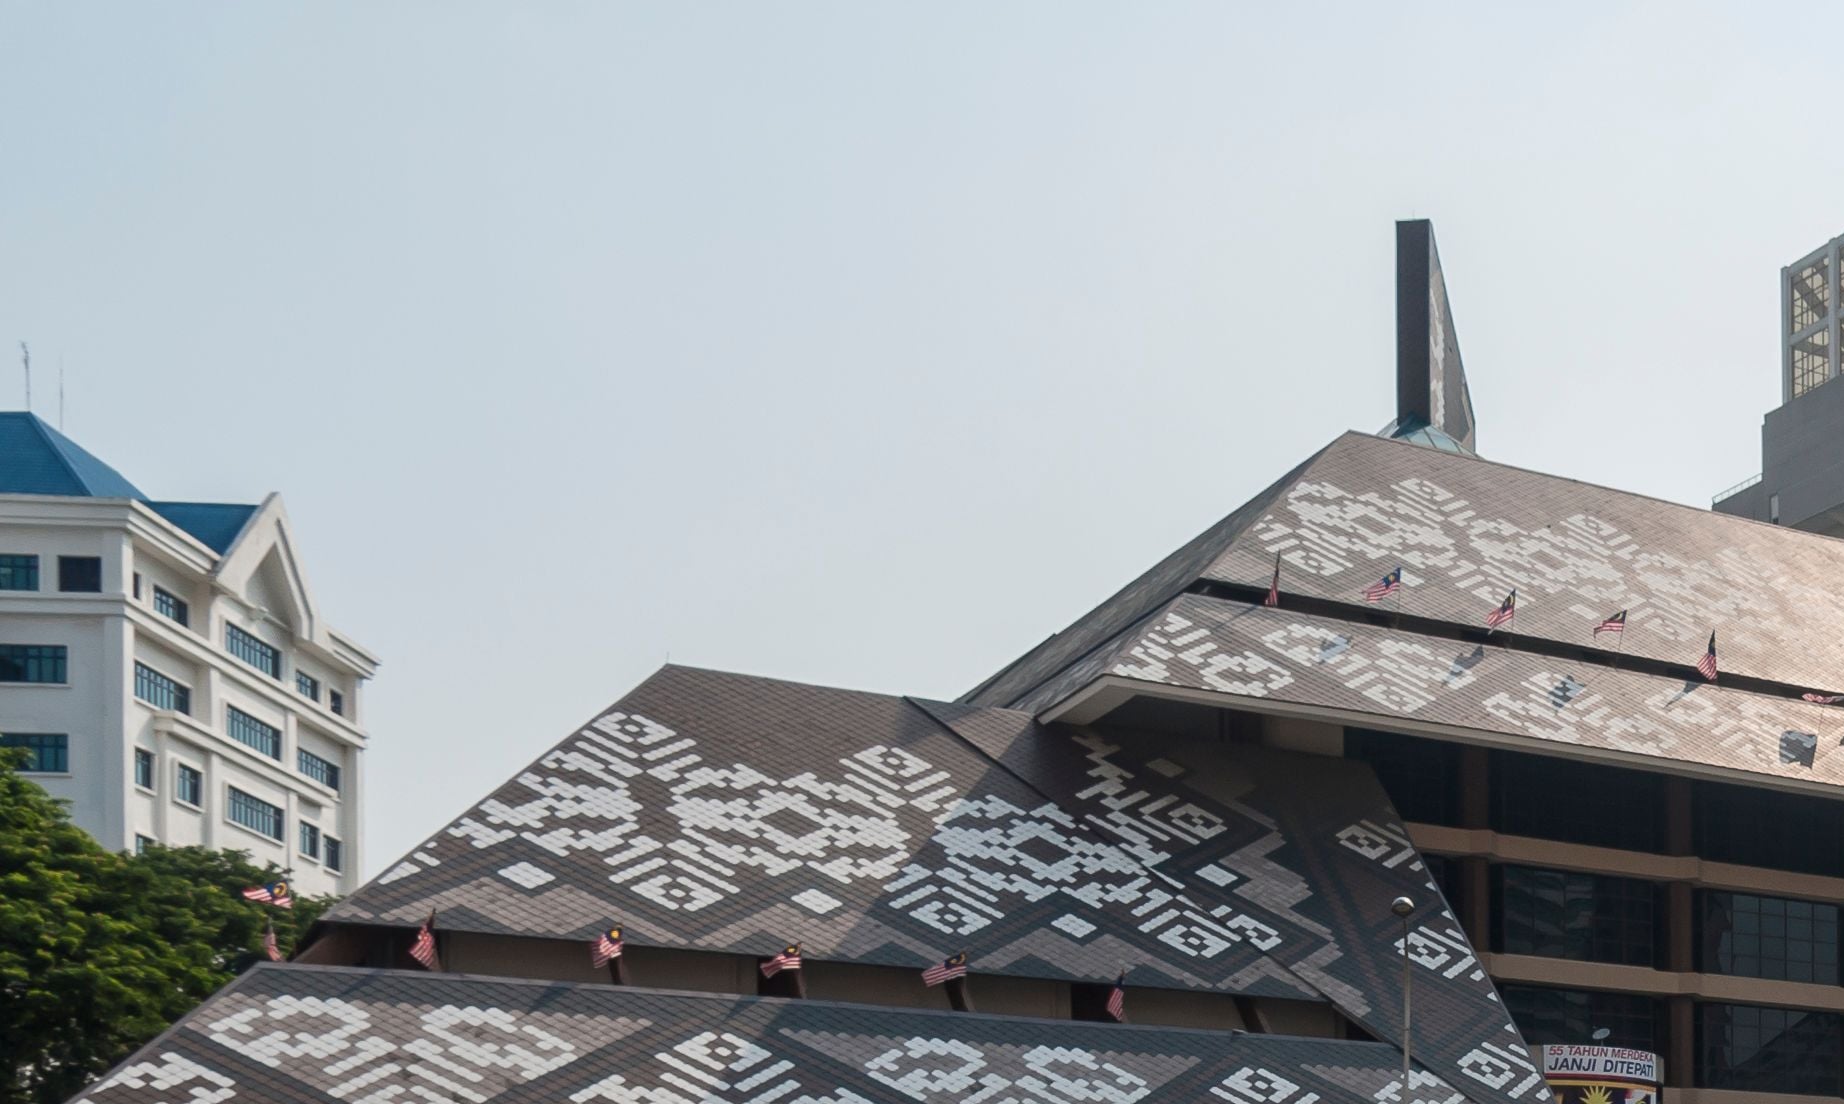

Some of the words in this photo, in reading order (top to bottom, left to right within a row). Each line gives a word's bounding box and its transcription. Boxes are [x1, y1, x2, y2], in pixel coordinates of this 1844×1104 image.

[1549, 1046, 1563, 1056] 55
[1568, 1046, 1609, 1057] TAHUN
[1611, 1048, 1653, 1062] MERDEKA
[1549, 1058, 1597, 1072] JANJI
[1603, 1060, 1654, 1077] DITEPATI
